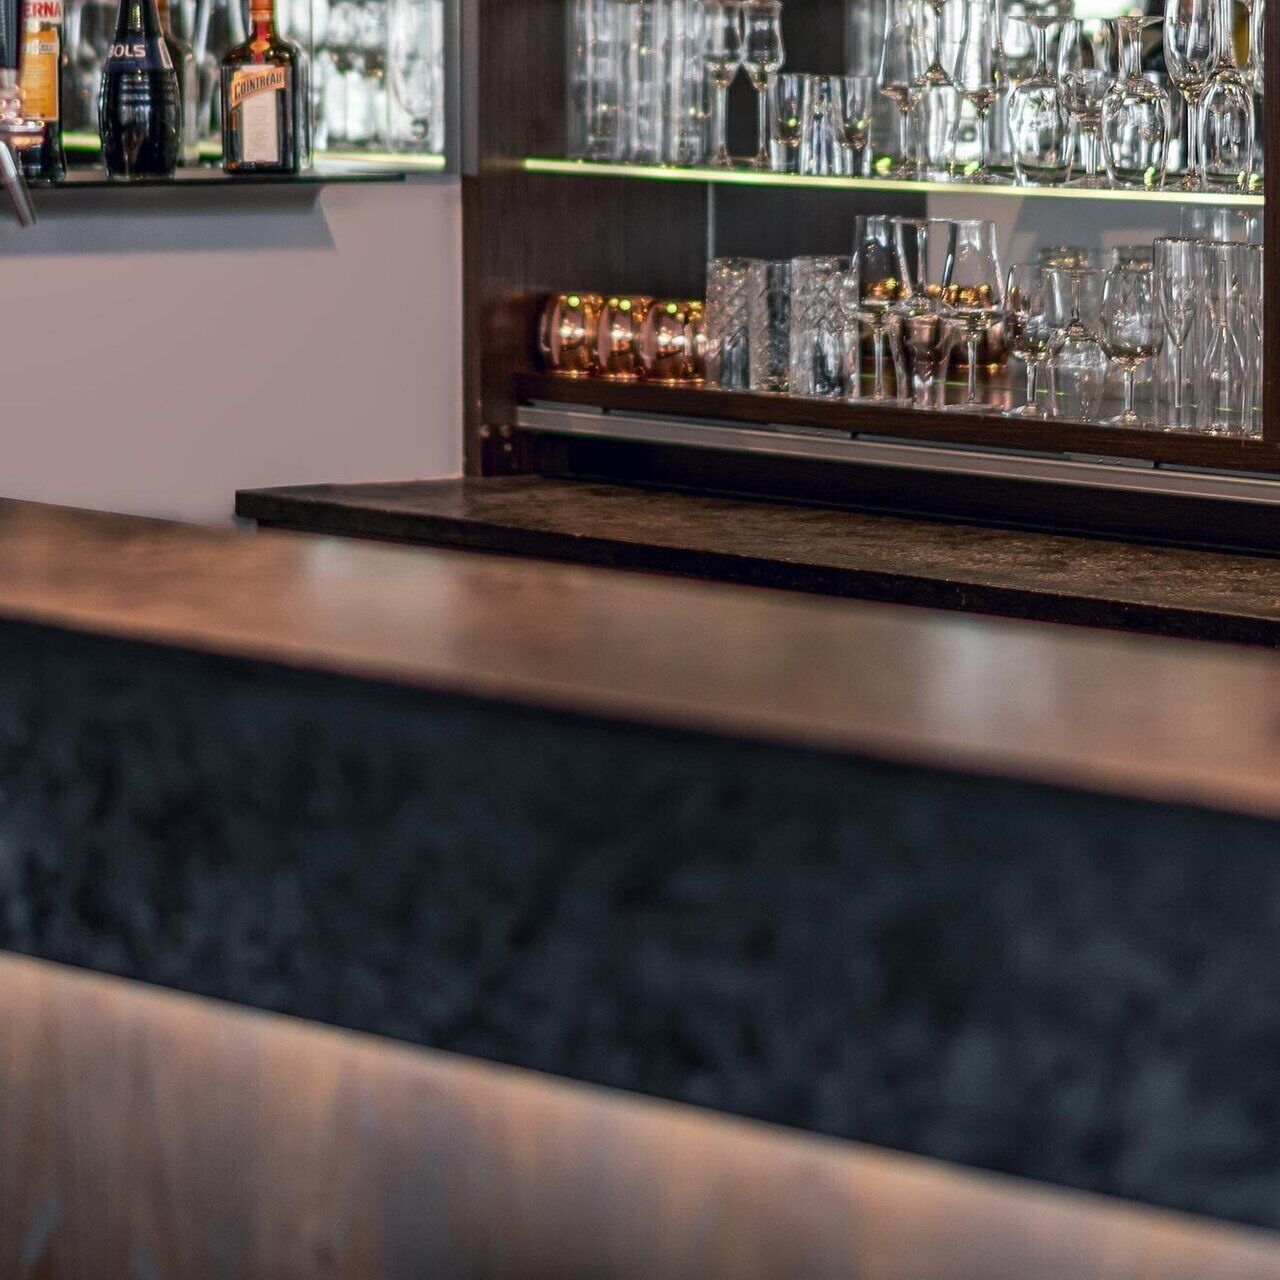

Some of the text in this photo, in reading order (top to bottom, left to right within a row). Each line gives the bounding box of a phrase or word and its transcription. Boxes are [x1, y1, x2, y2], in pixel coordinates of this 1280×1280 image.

[23, 1, 61, 17] ERNA
[109, 44, 146, 59] BOLS
[234, 73, 282, 100] COINTREAU
